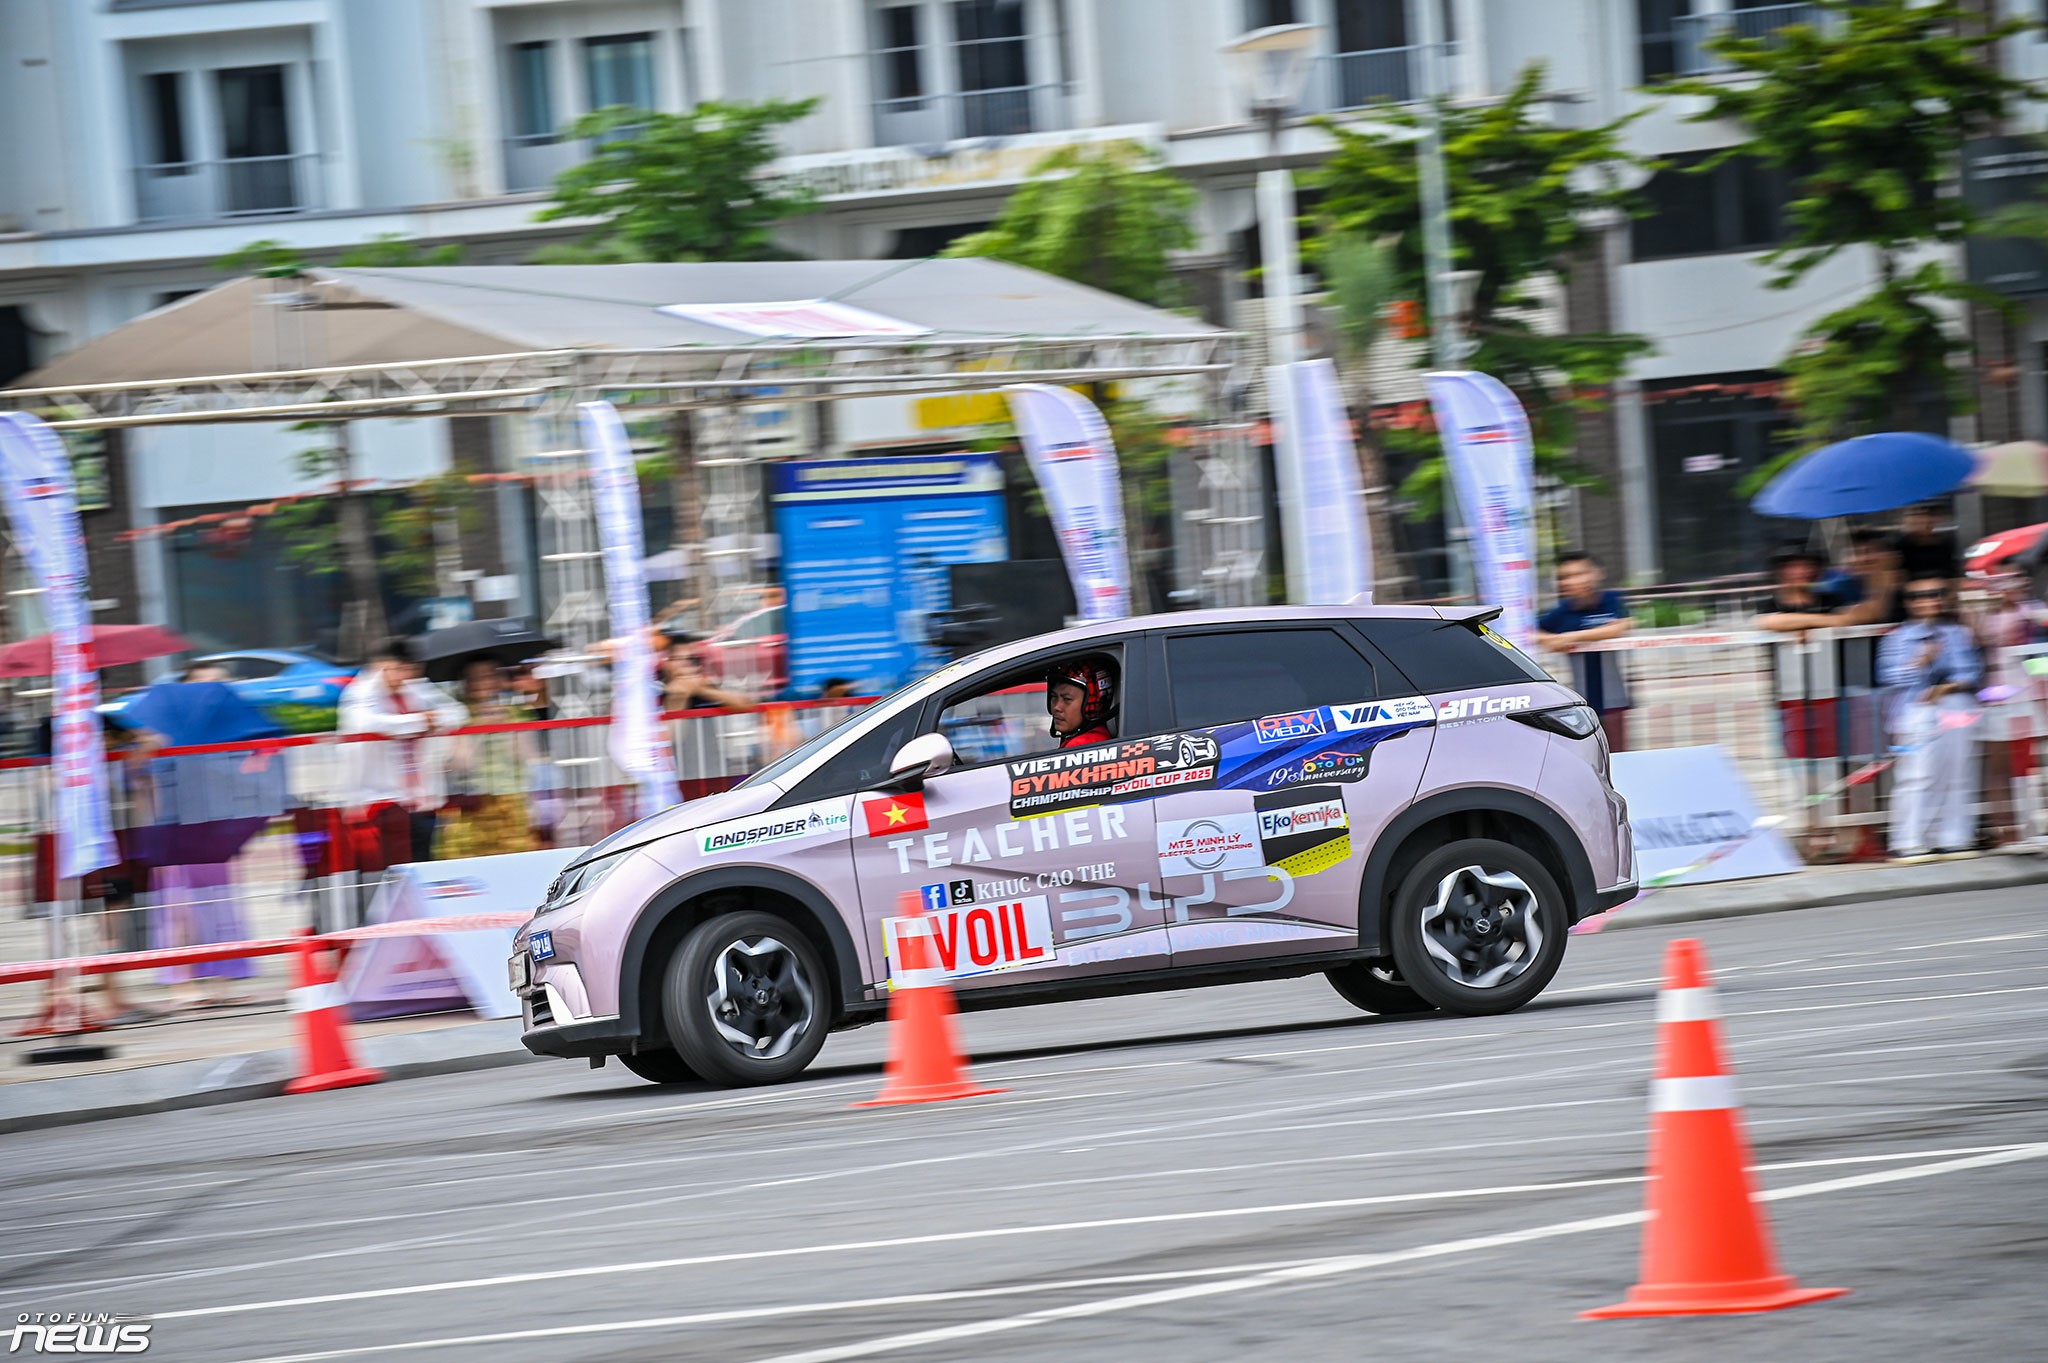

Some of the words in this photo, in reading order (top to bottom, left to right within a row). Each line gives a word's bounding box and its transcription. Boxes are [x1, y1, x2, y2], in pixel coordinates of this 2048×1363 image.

[1438, 695, 1531, 721] BITCAR
[1259, 713, 1316, 730] OTV
[1262, 723, 1321, 740] MEDIA
[1440, 721, 1464, 729] BEST
[1479, 715, 1505, 723] TOWN
[1011, 746, 1117, 776] VIETNAM
[1304, 757, 1364, 772] OTOFUN
[1012, 757, 1155, 796] GYMKHANA
[1288, 766, 1365, 783] Anniversary
[1012, 786, 1112, 809] CHAMPIONSHIP
[1114, 777, 1150, 793] PVOIL
[1155, 773, 1180, 786] CUP
[1184, 769, 1212, 780] 2025
[704, 819, 806, 852] LANDSPIDER
[825, 813, 848, 826] tire
[1263, 805, 1342, 835] Ekokemika
[888, 806, 1128, 873] TEACHER
[1169, 839, 1194, 849] MTS
[1197, 836, 1225, 846] MINH
[1158, 849, 1196, 858] ELECTRIC
[977, 876, 1031, 900] KHUC
[1036, 869, 1074, 889] CAO
[1077, 862, 1117, 882] THE
